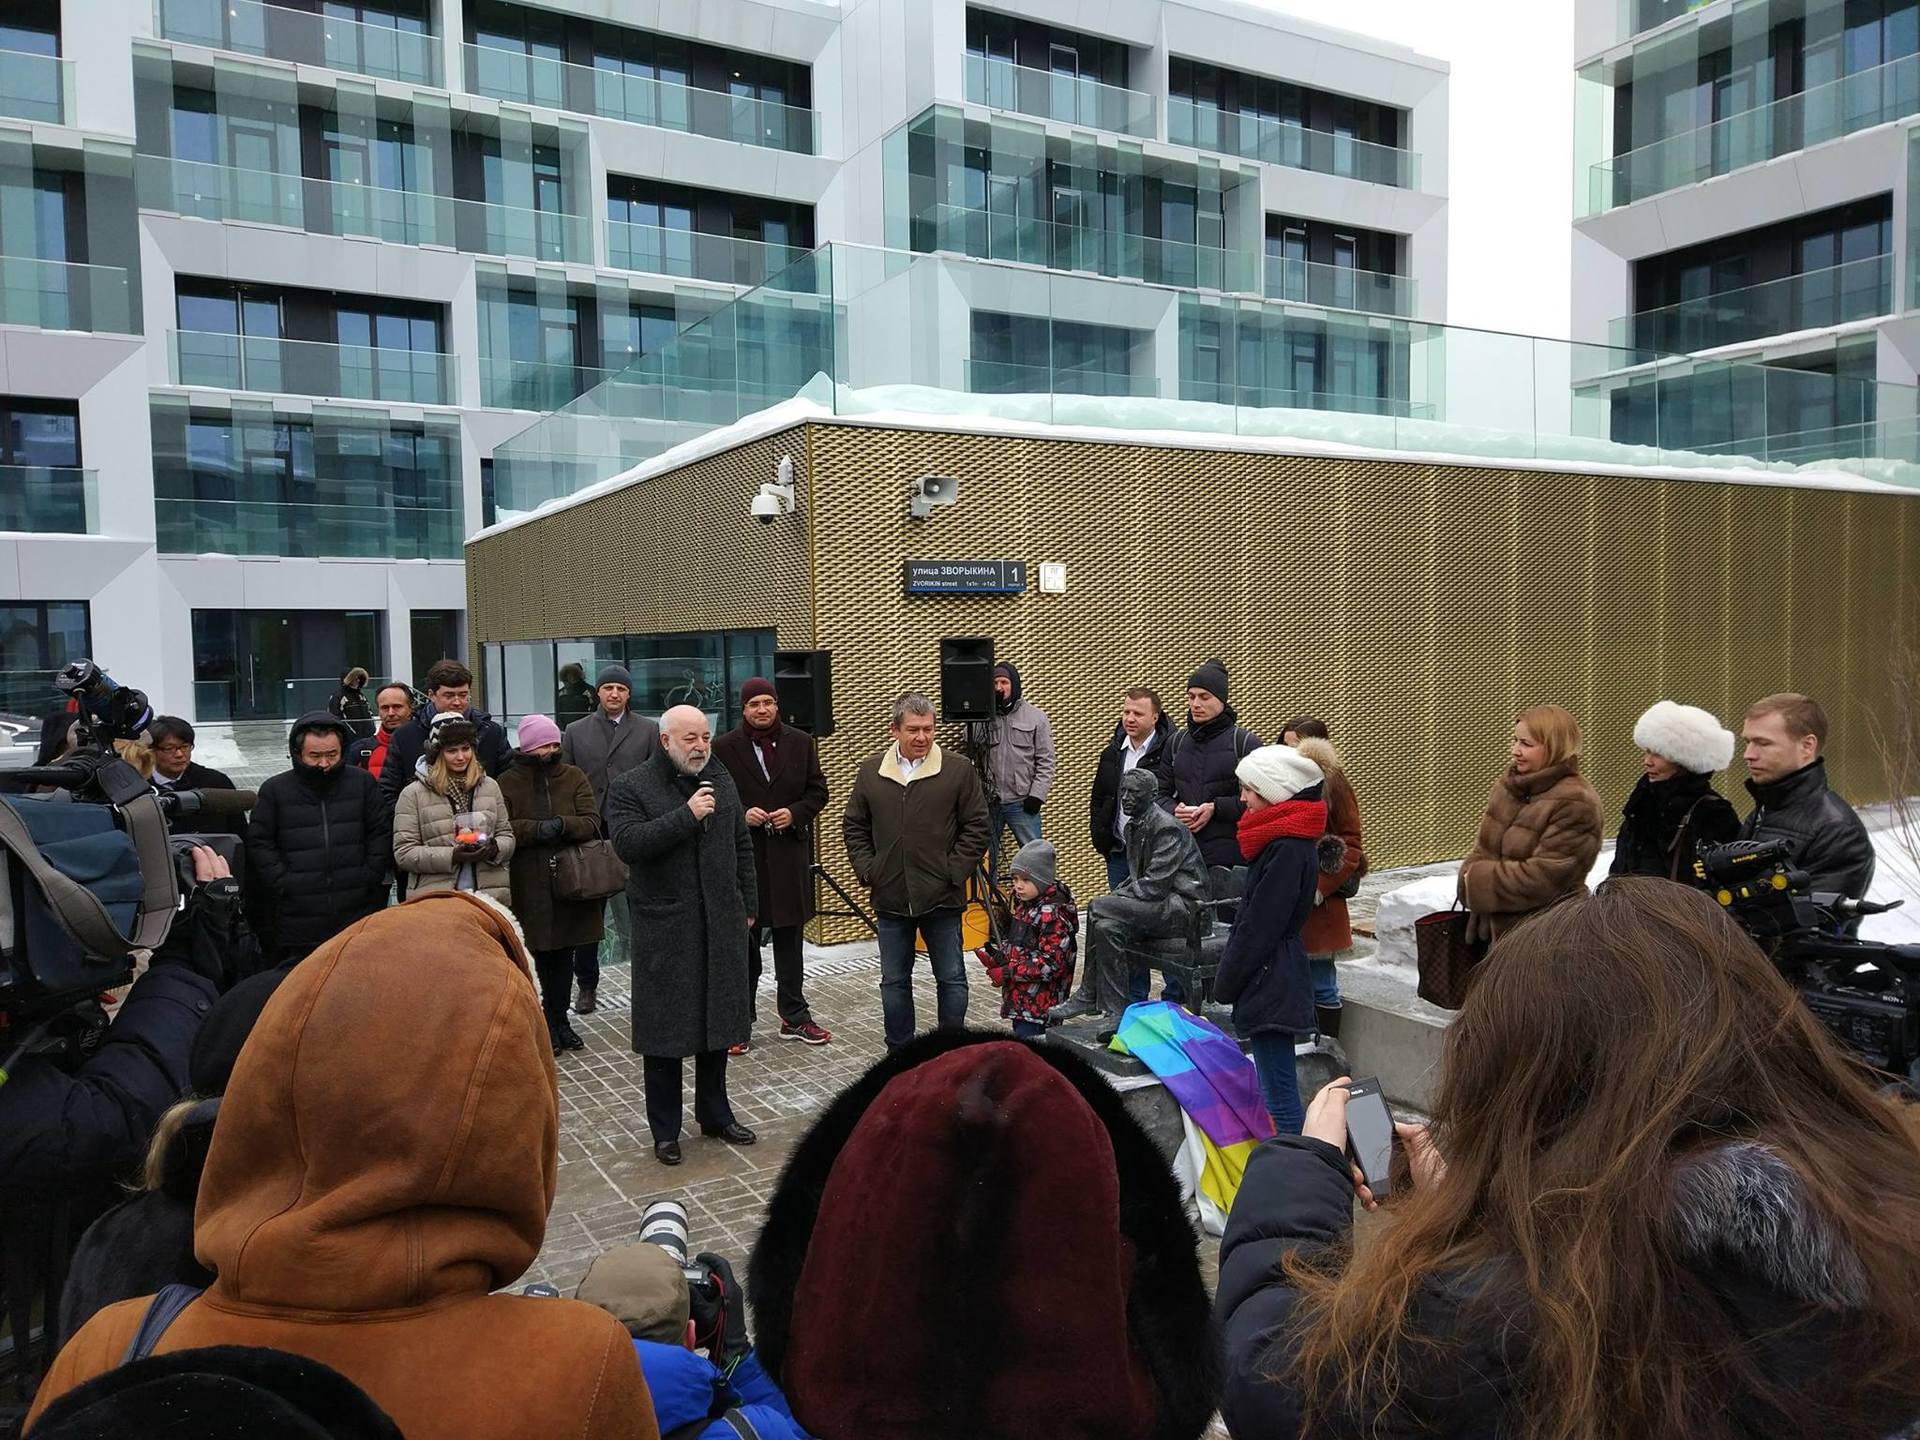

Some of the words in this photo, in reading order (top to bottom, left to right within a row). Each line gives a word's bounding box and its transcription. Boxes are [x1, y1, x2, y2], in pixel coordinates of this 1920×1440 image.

[912, 567, 939, 577] улица
[940, 566, 996, 575] ЗВОРЫКИНА
[1011, 567, 1018, 582] 1
